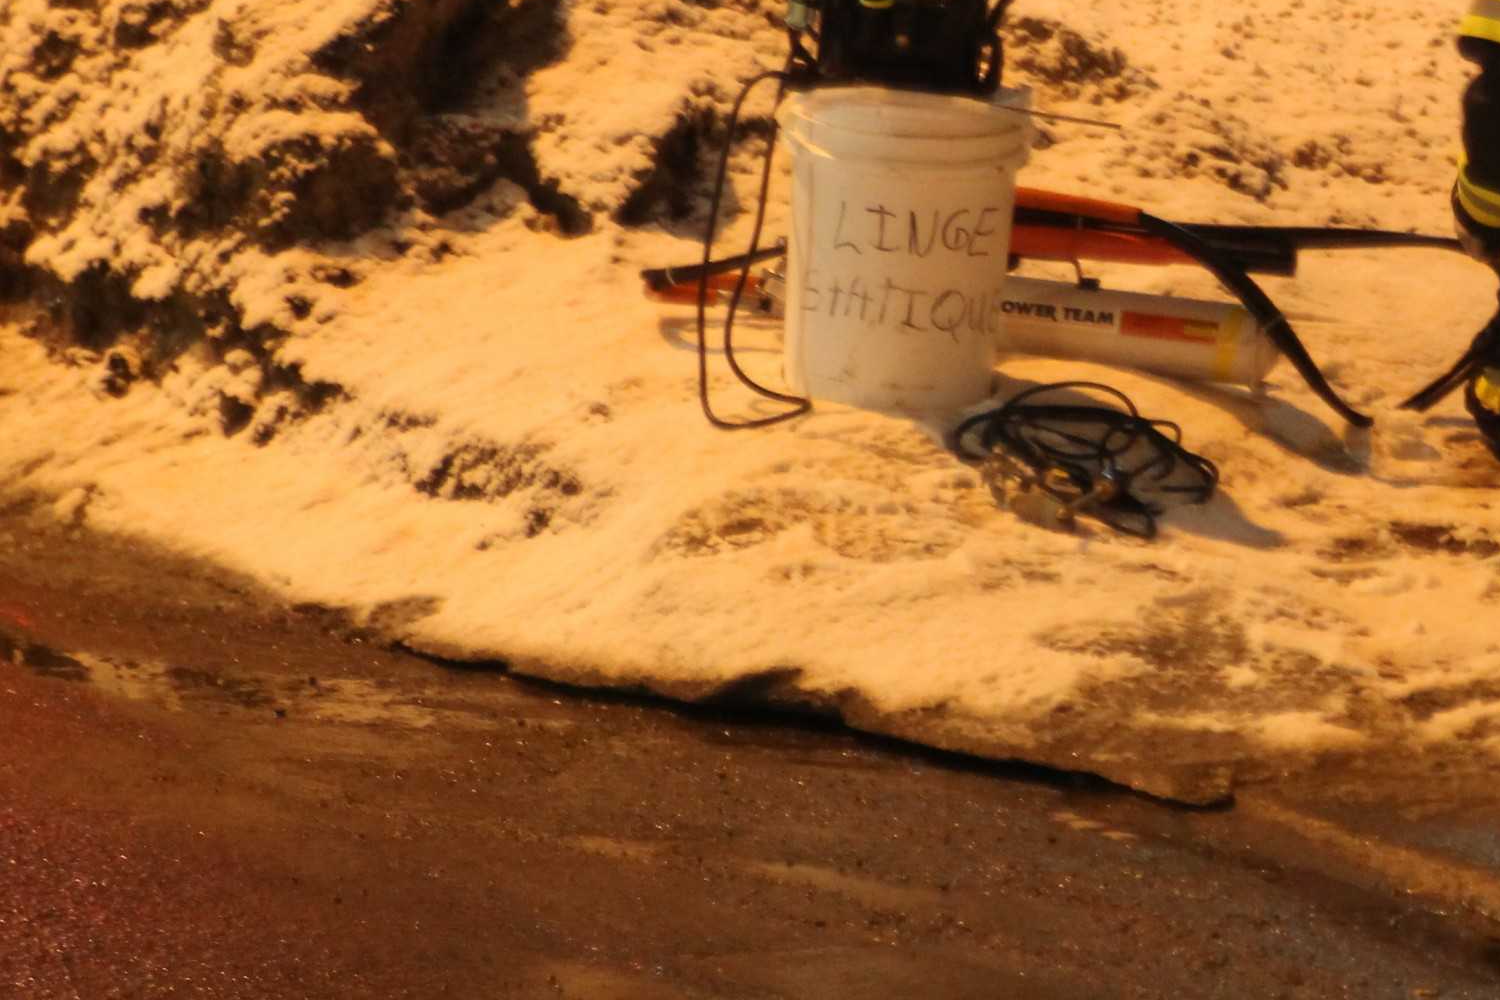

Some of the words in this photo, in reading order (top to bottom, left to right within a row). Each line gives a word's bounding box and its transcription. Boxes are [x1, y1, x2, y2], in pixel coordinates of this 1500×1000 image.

[832, 200, 1000, 258] LINGE
[1001, 300, 1057, 323] OWER
[1062, 306, 1114, 326] TEAM
